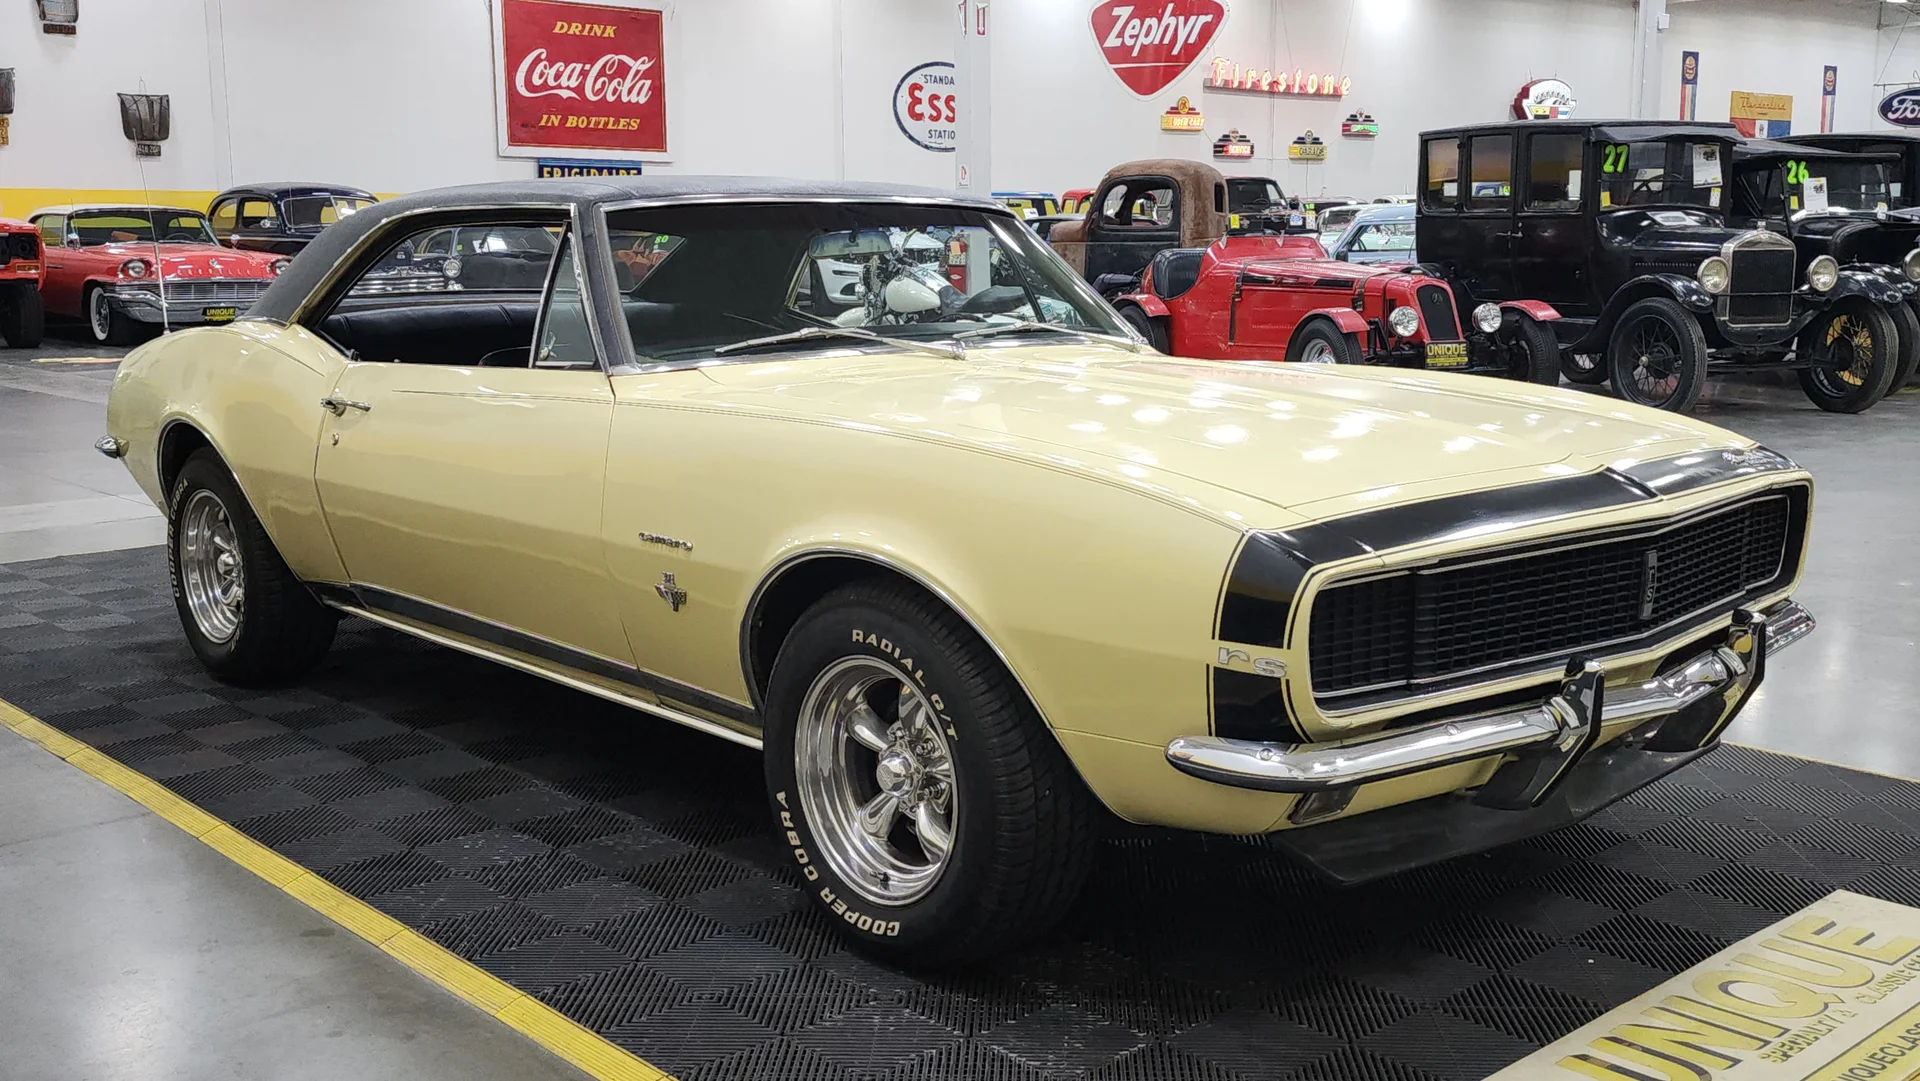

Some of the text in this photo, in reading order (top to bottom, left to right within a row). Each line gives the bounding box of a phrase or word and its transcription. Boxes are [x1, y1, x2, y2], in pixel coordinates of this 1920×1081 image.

[552, 21, 618, 38] DRINK
[1103, 6, 1213, 57] Zephyr
[515, 48, 656, 105] Coca-Cola
[923, 74, 955, 86] STANDA
[1211, 56, 1351, 96] Firestone
[1887, 95, 1920, 120] Fo
[538, 114, 640, 131] IN BOTTLES
[927, 129, 956, 140] STATIO
[1603, 144, 1629, 173] 27
[1787, 160, 1809, 184] 26
[206, 308, 235, 316] UNIQUE
[1427, 343, 1467, 355] UNIQUE
[851, 629, 959, 742] RADIAL G/T
[775, 790, 901, 937] COOPER COBRA
[1555, 915, 1920, 1081] UNIQUE
[1759, 1013, 1846, 1064] SPECIALTY
